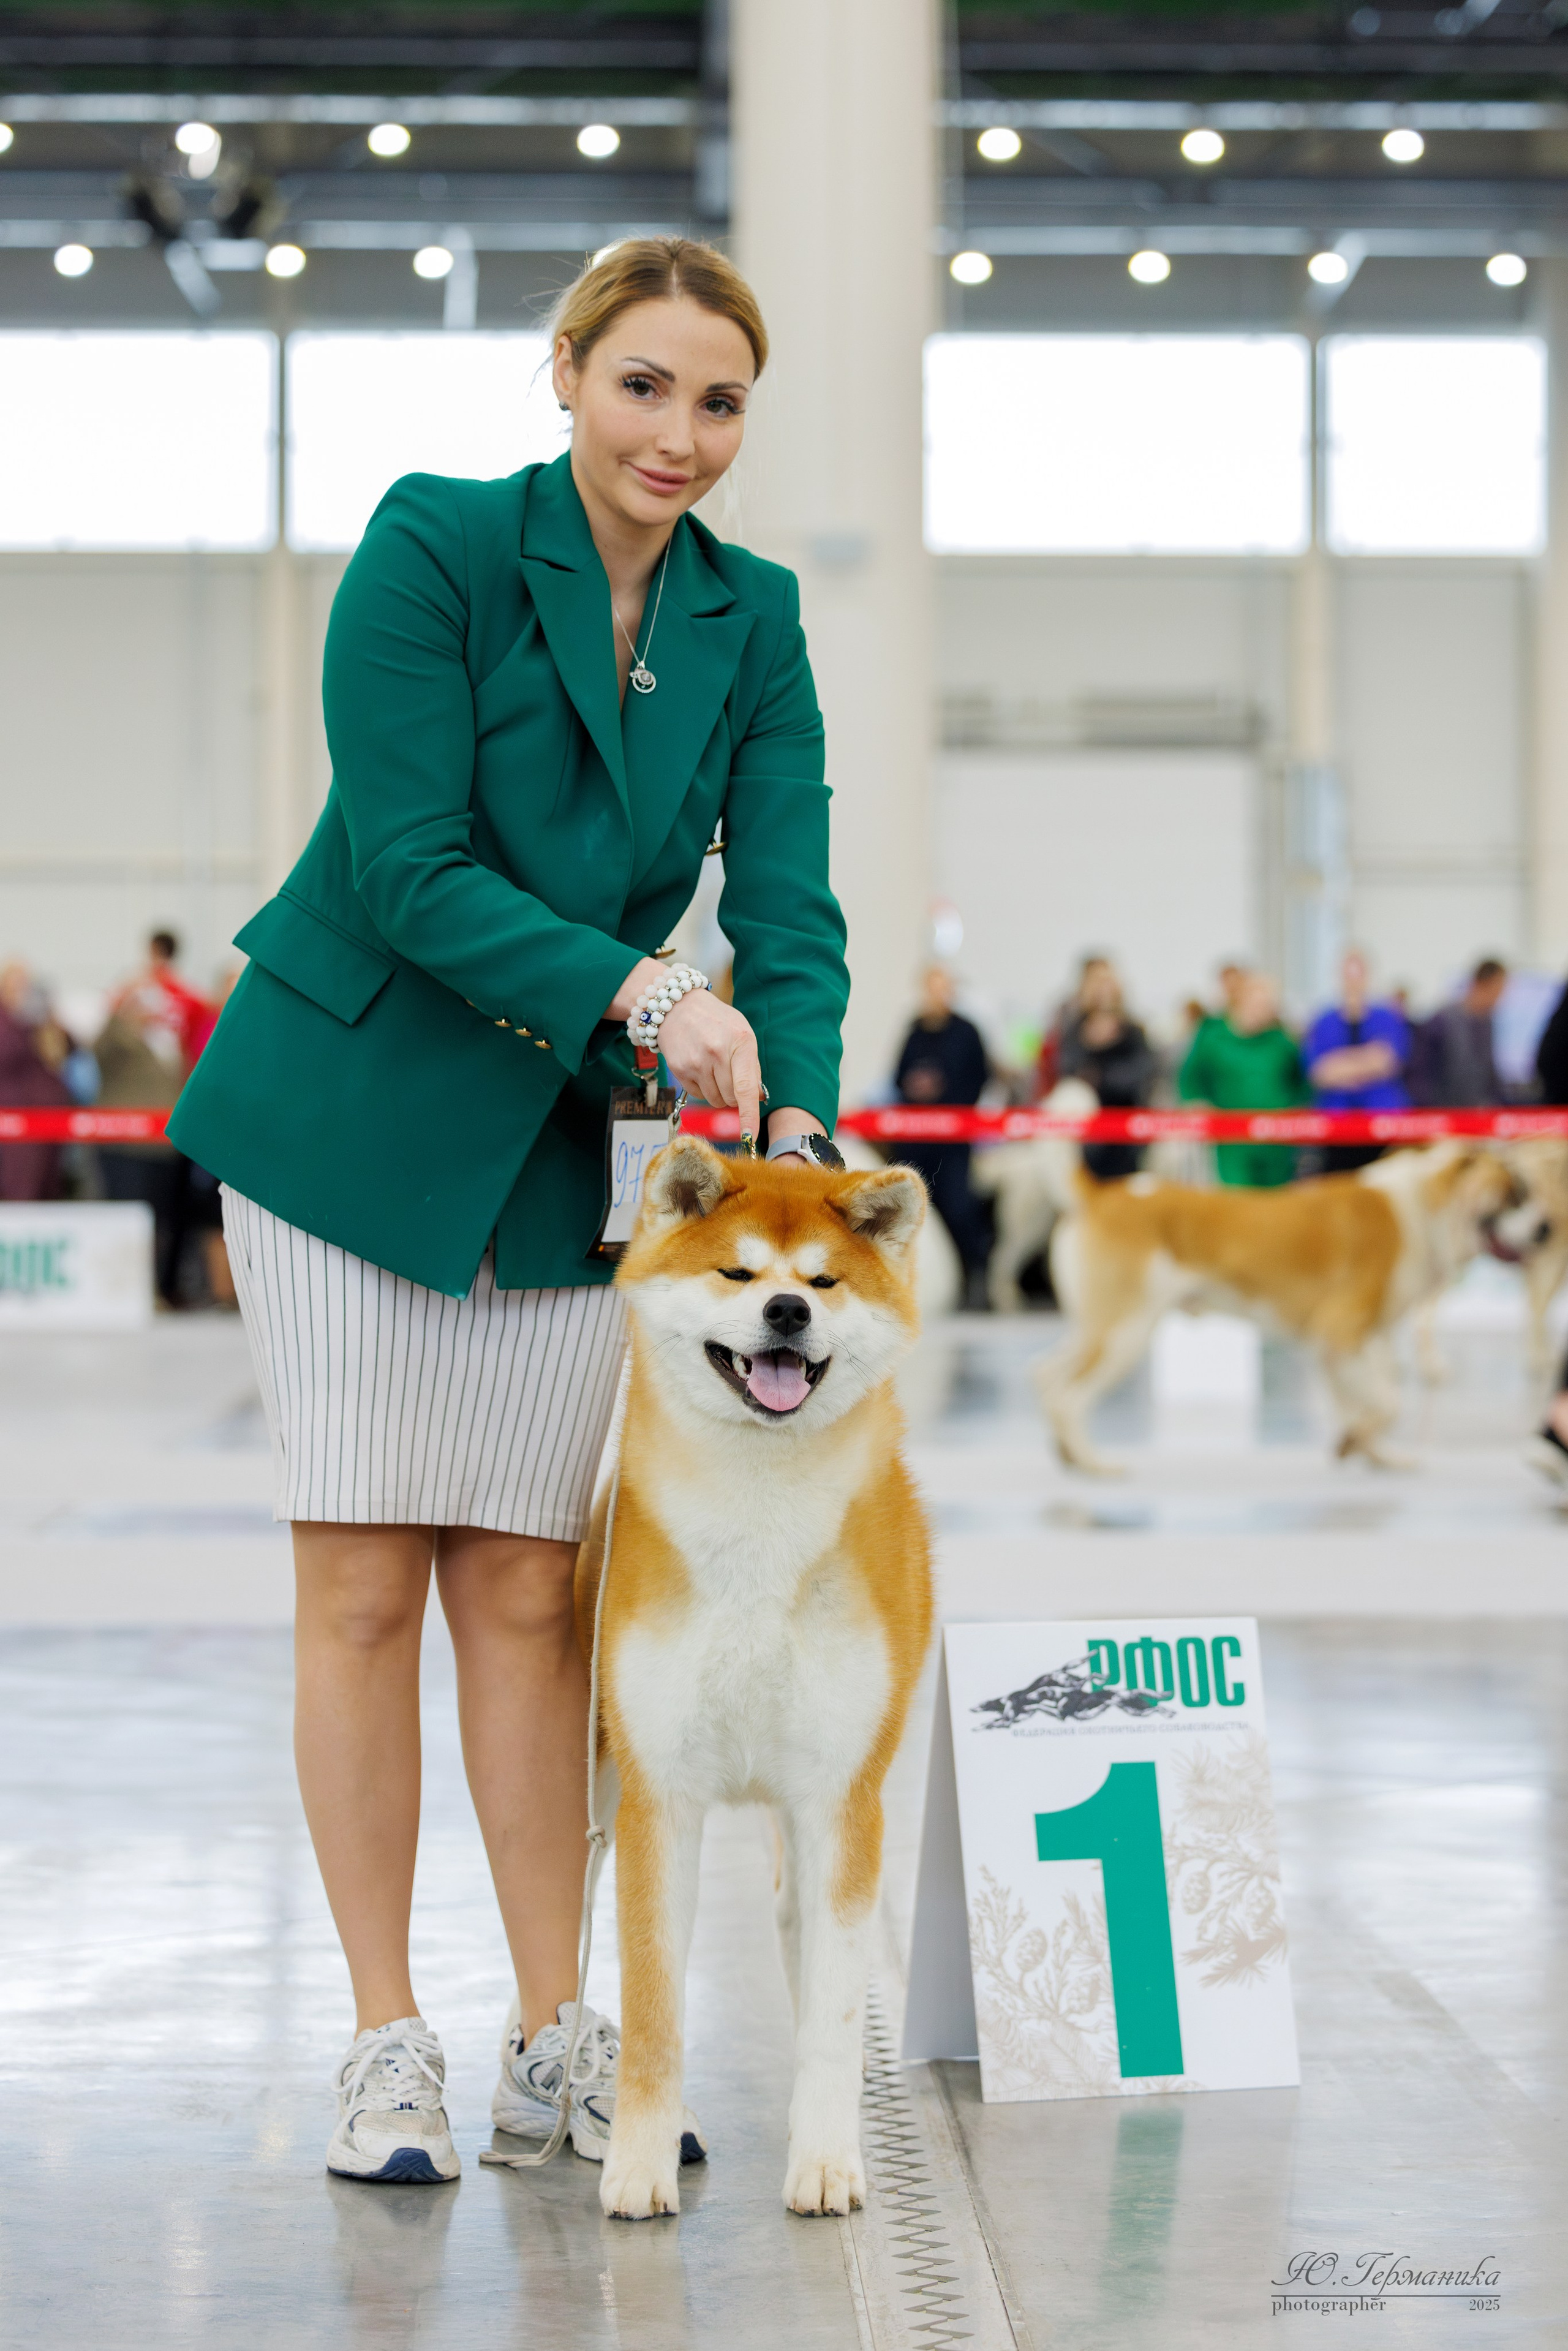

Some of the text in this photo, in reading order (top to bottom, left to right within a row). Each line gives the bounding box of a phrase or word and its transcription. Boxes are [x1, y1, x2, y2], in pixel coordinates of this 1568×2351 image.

[614, 1141, 668, 1209] 97
[1087, 1636, 1245, 1708] РФОС
[1035, 1761, 1185, 2078] 1
